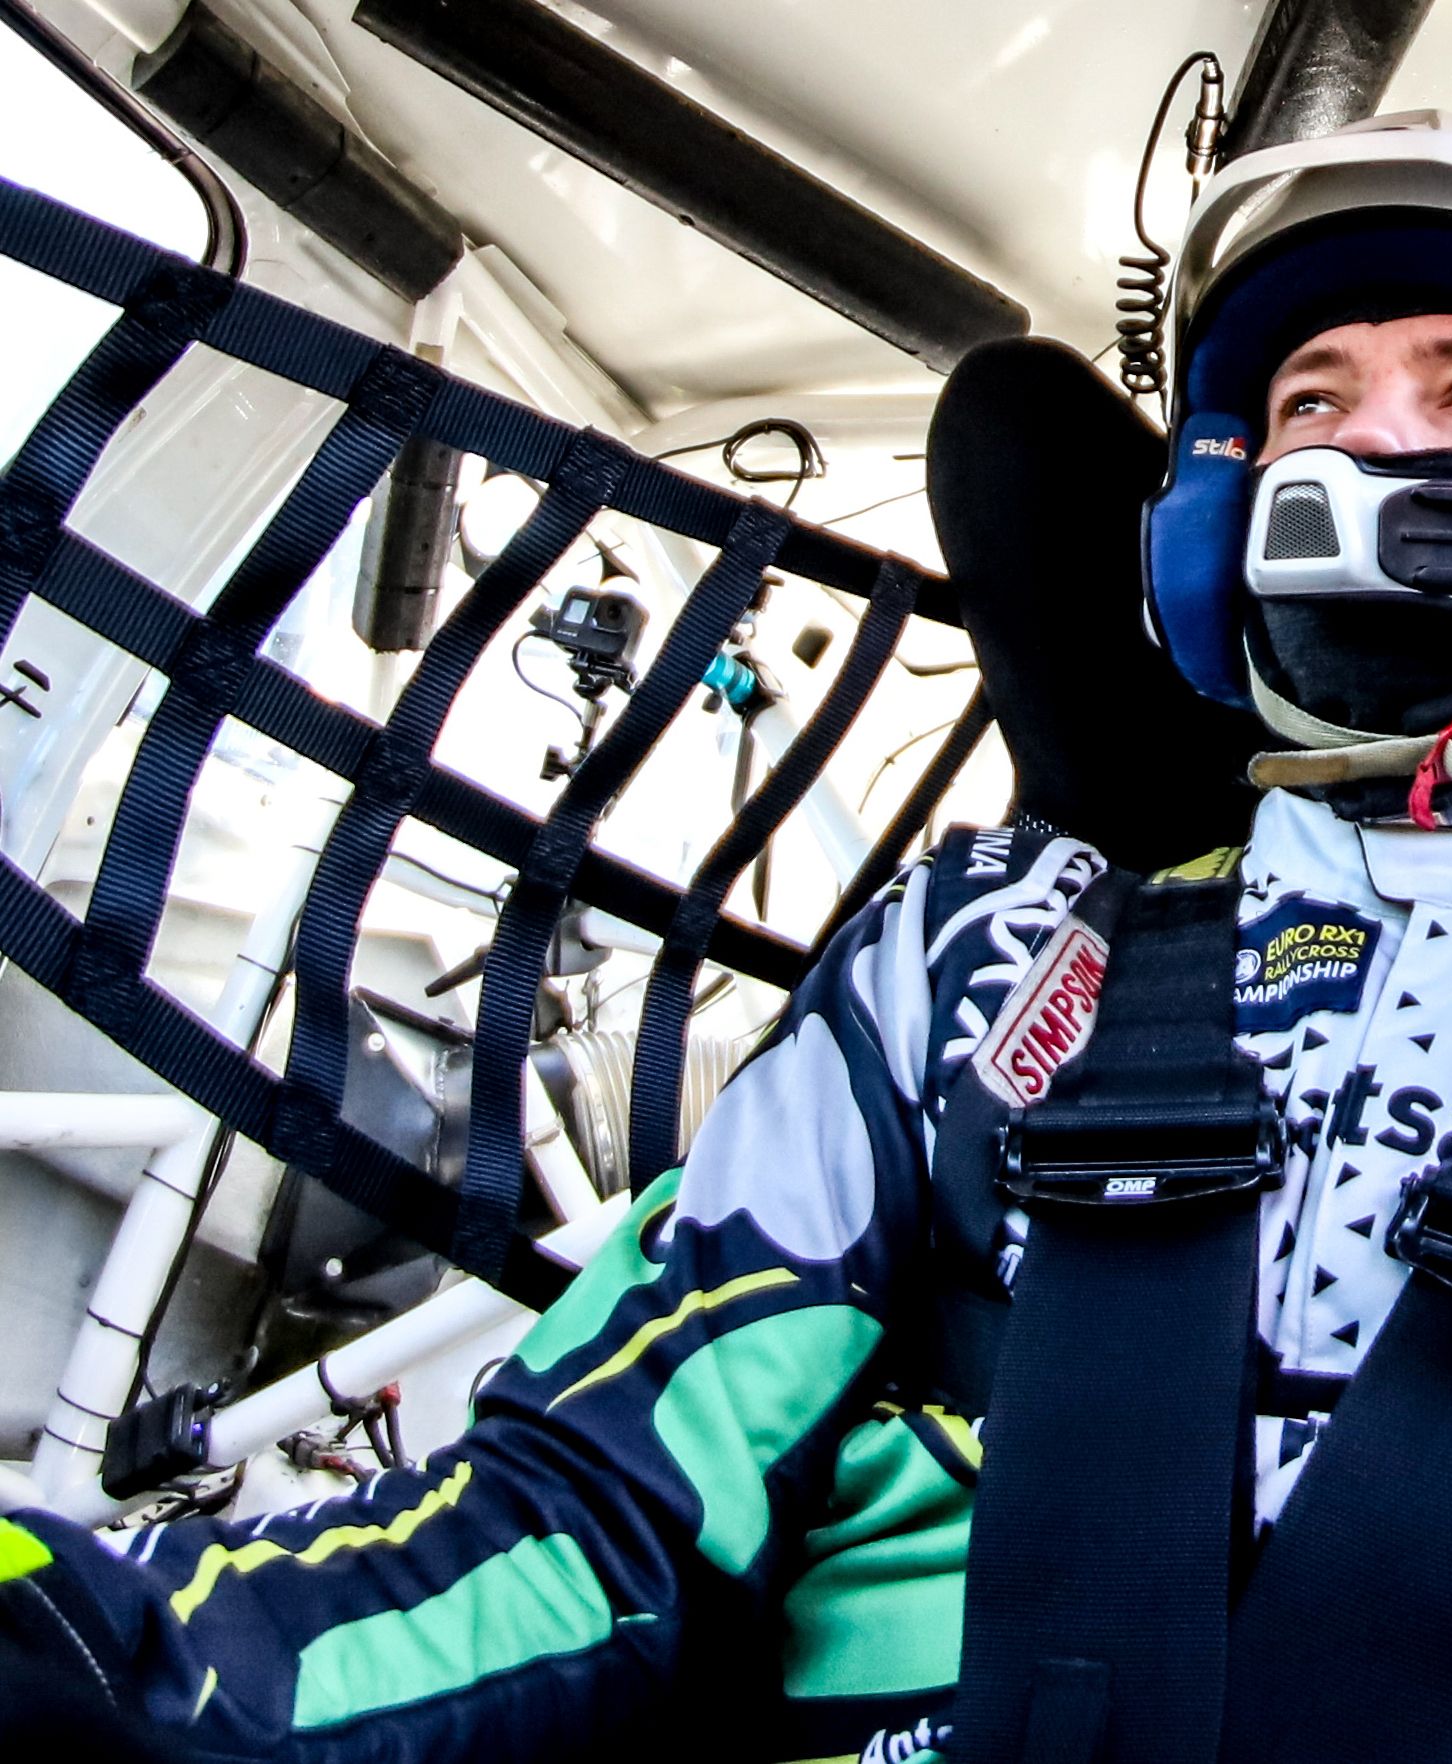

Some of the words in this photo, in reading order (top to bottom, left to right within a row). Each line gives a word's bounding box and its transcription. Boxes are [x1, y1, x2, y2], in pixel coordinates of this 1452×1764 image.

[1266, 924, 1316, 962] EURO
[1319, 924, 1366, 945] RX1
[1264, 944, 1360, 981] RALLYCROSS
[1106, 1180, 1156, 1193] OMP
